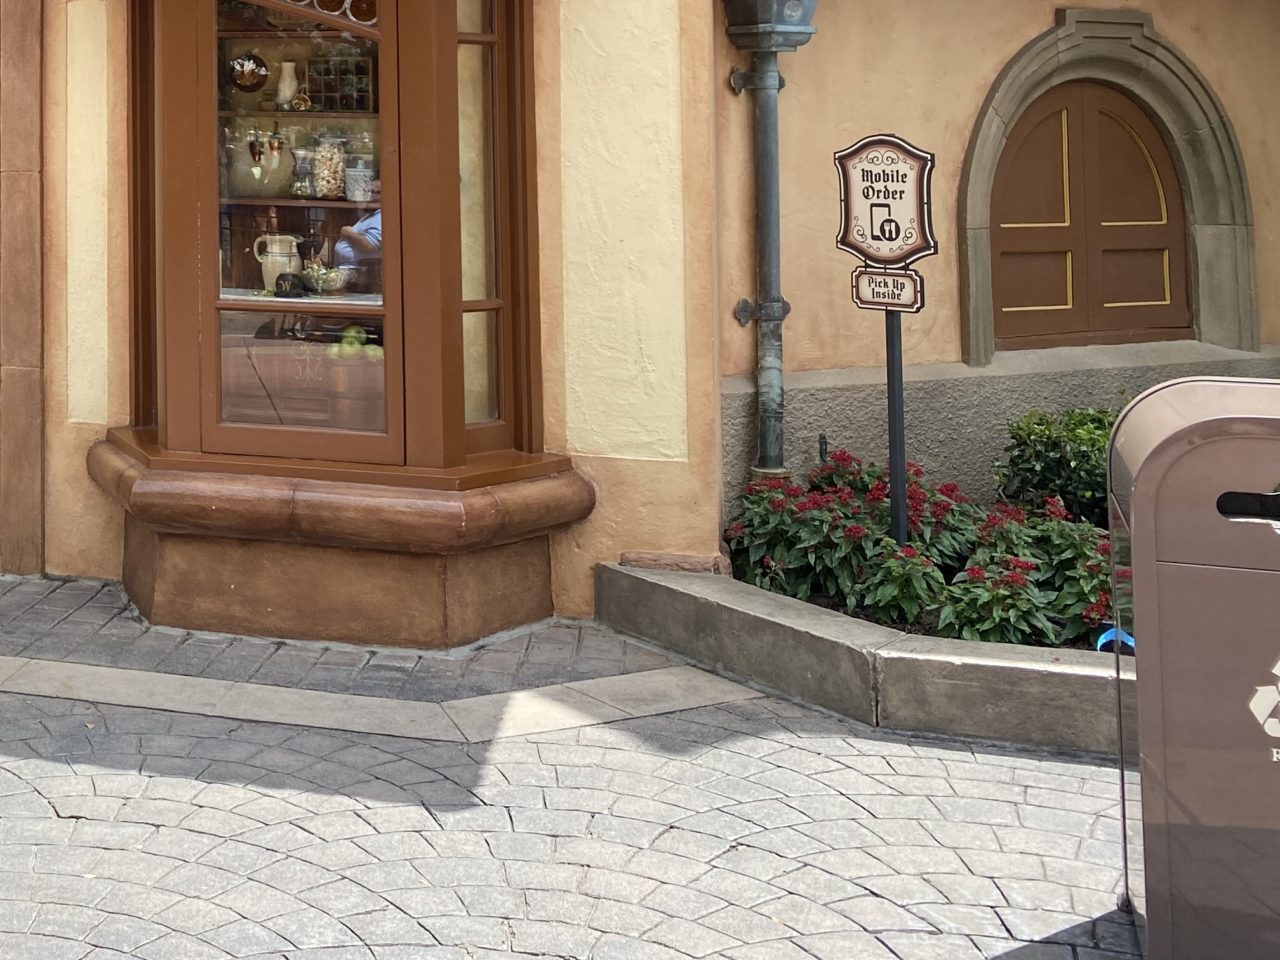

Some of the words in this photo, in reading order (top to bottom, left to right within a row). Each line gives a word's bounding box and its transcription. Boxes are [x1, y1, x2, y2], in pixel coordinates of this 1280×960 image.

[861, 168, 908, 184] Mobile
[862, 185, 905, 200] Order
[868, 276, 889, 289] Pick
[892, 278, 906, 292] Up
[871, 287, 902, 300] Inside
